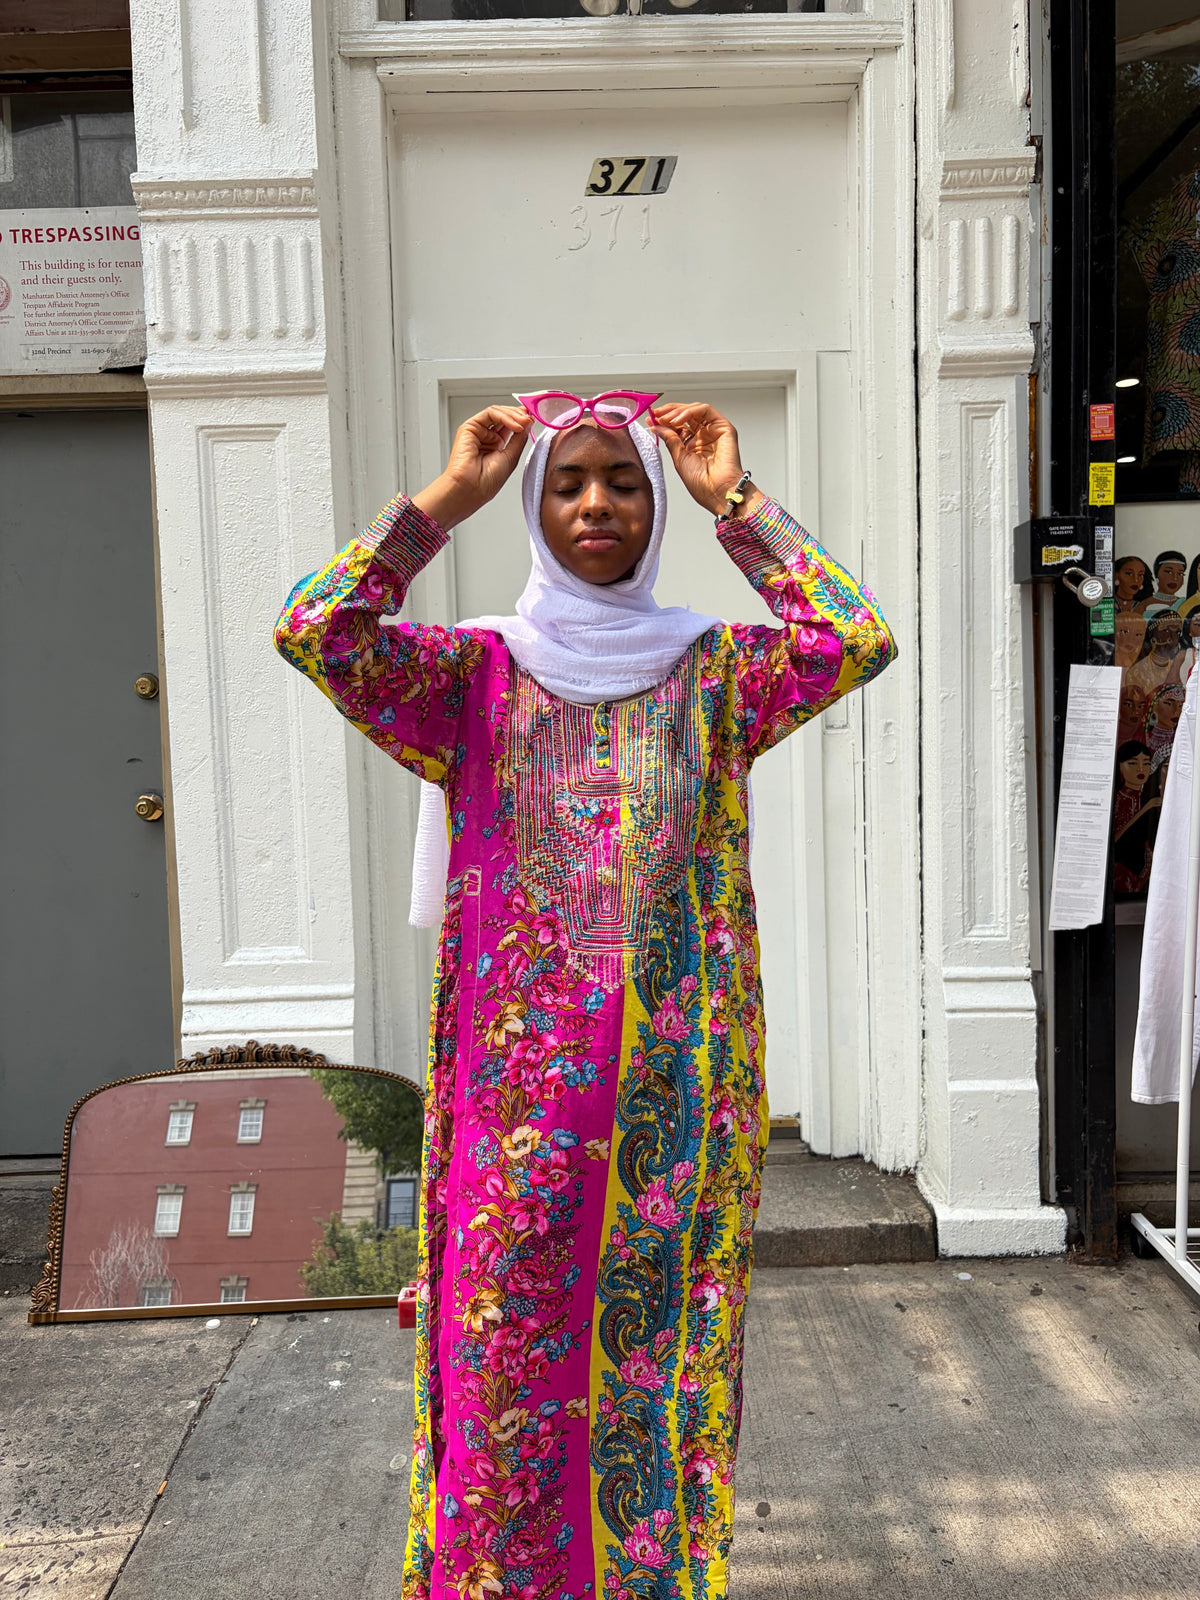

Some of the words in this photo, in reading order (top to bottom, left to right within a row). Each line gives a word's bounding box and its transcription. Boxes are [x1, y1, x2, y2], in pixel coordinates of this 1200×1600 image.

[590, 158, 667, 194] 371
[567, 204, 652, 252] 371
[9, 225, 140, 244] TRESPASSING
[19, 260, 42, 271] This
[44, 259, 85, 272] building
[88, 258, 96, 269] is
[98, 257, 112, 269] for
[115, 260, 143, 269] tenan
[21, 274, 39, 286] and
[41, 273, 64, 285] their
[66, 276, 96, 287] guests
[98, 272, 122, 286] only.
[22, 292, 55, 300] Manhattan
[55, 291, 79, 299] District
[110, 290, 131, 298] Office
[22, 302, 47, 311] Trespass
[47, 300, 74, 309] Affidavit
[74, 300, 100, 309] Program
[23, 311, 34, 319] For
[34, 310, 56, 318] further
[93, 309, 112, 318] please
[24, 320, 47, 328] District
[98, 318, 135, 326] Community
[24, 329, 45, 337] Affairs
[45, 328, 60, 336] Unit
[31, 347, 46, 356] 32nd
[47, 346, 72, 355] Precinct
